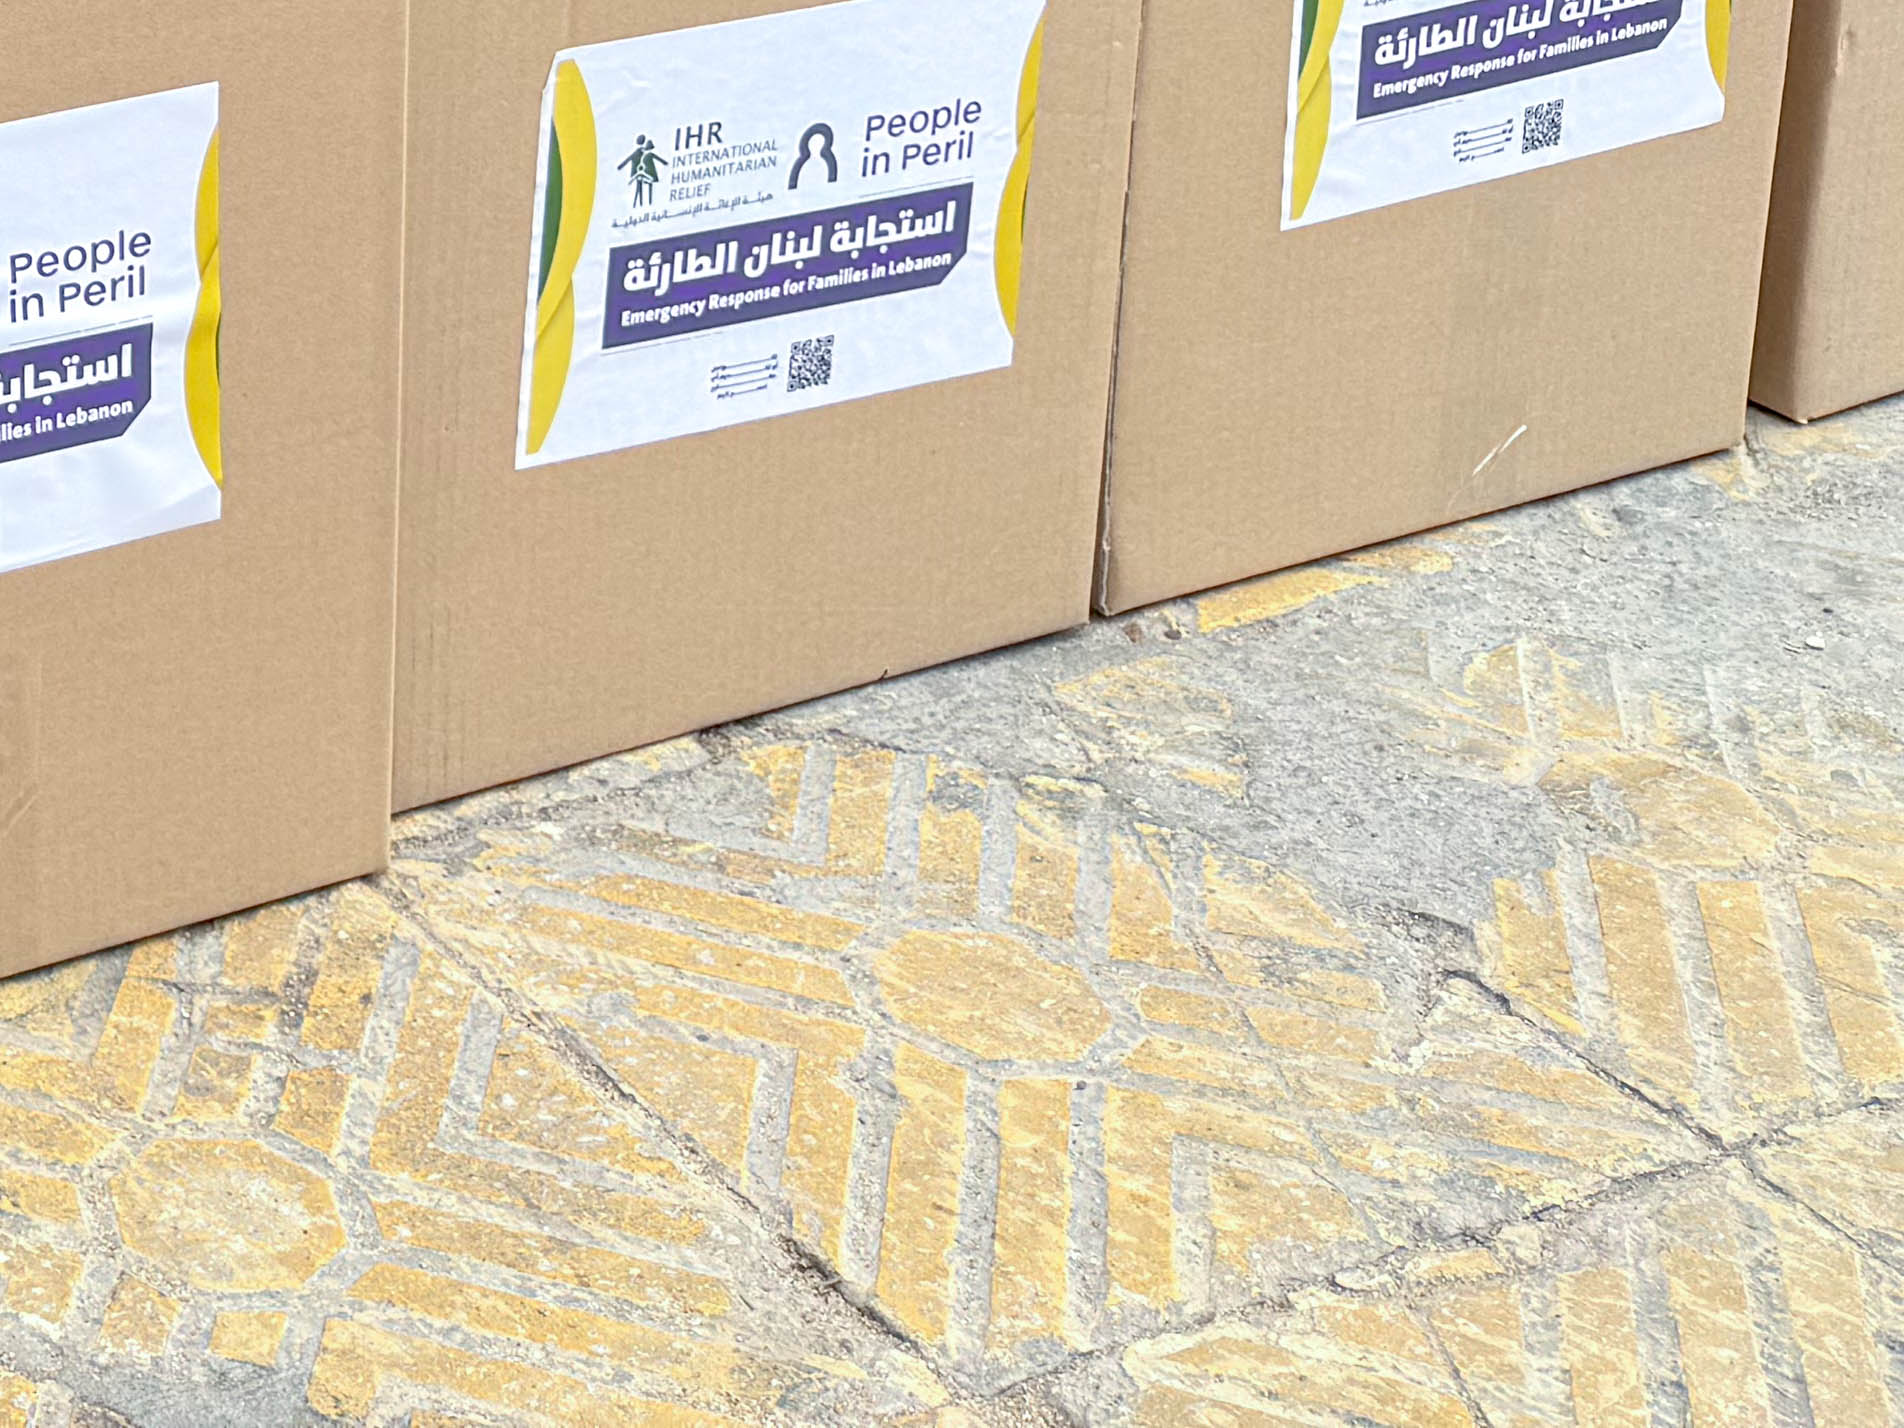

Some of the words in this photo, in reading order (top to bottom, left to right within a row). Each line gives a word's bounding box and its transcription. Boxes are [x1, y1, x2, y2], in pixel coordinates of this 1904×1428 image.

[1373, 70, 1449, 99] Emergency
[1450, 55, 1516, 80] Response
[1517, 47, 1538, 65] for
[1538, 34, 1594, 60] Families
[1595, 29, 1609, 46] in
[1610, 18, 1668, 42] Lebanon
[1374, 14, 1478, 70] الطارئة
[674, 121, 723, 152] IHR
[865, 98, 982, 142] People
[861, 146, 891, 178] in
[901, 130, 974, 171] Peril
[9, 229, 152, 284] People
[743, 225, 823, 278] لبنان
[829, 200, 957, 260] استجابة
[9, 288, 44, 323] in
[59, 264, 145, 313] Peril
[621, 299, 707, 327] Emergency
[708, 285, 781, 310] Response
[782, 278, 806, 296] for
[807, 266, 869, 291] Families
[870, 262, 887, 280] in
[888, 252, 952, 276] Lebanon
[623, 240, 739, 297] الطارئة
[35, 415, 53, 434] in
[56, 400, 134, 429] Lebanon
